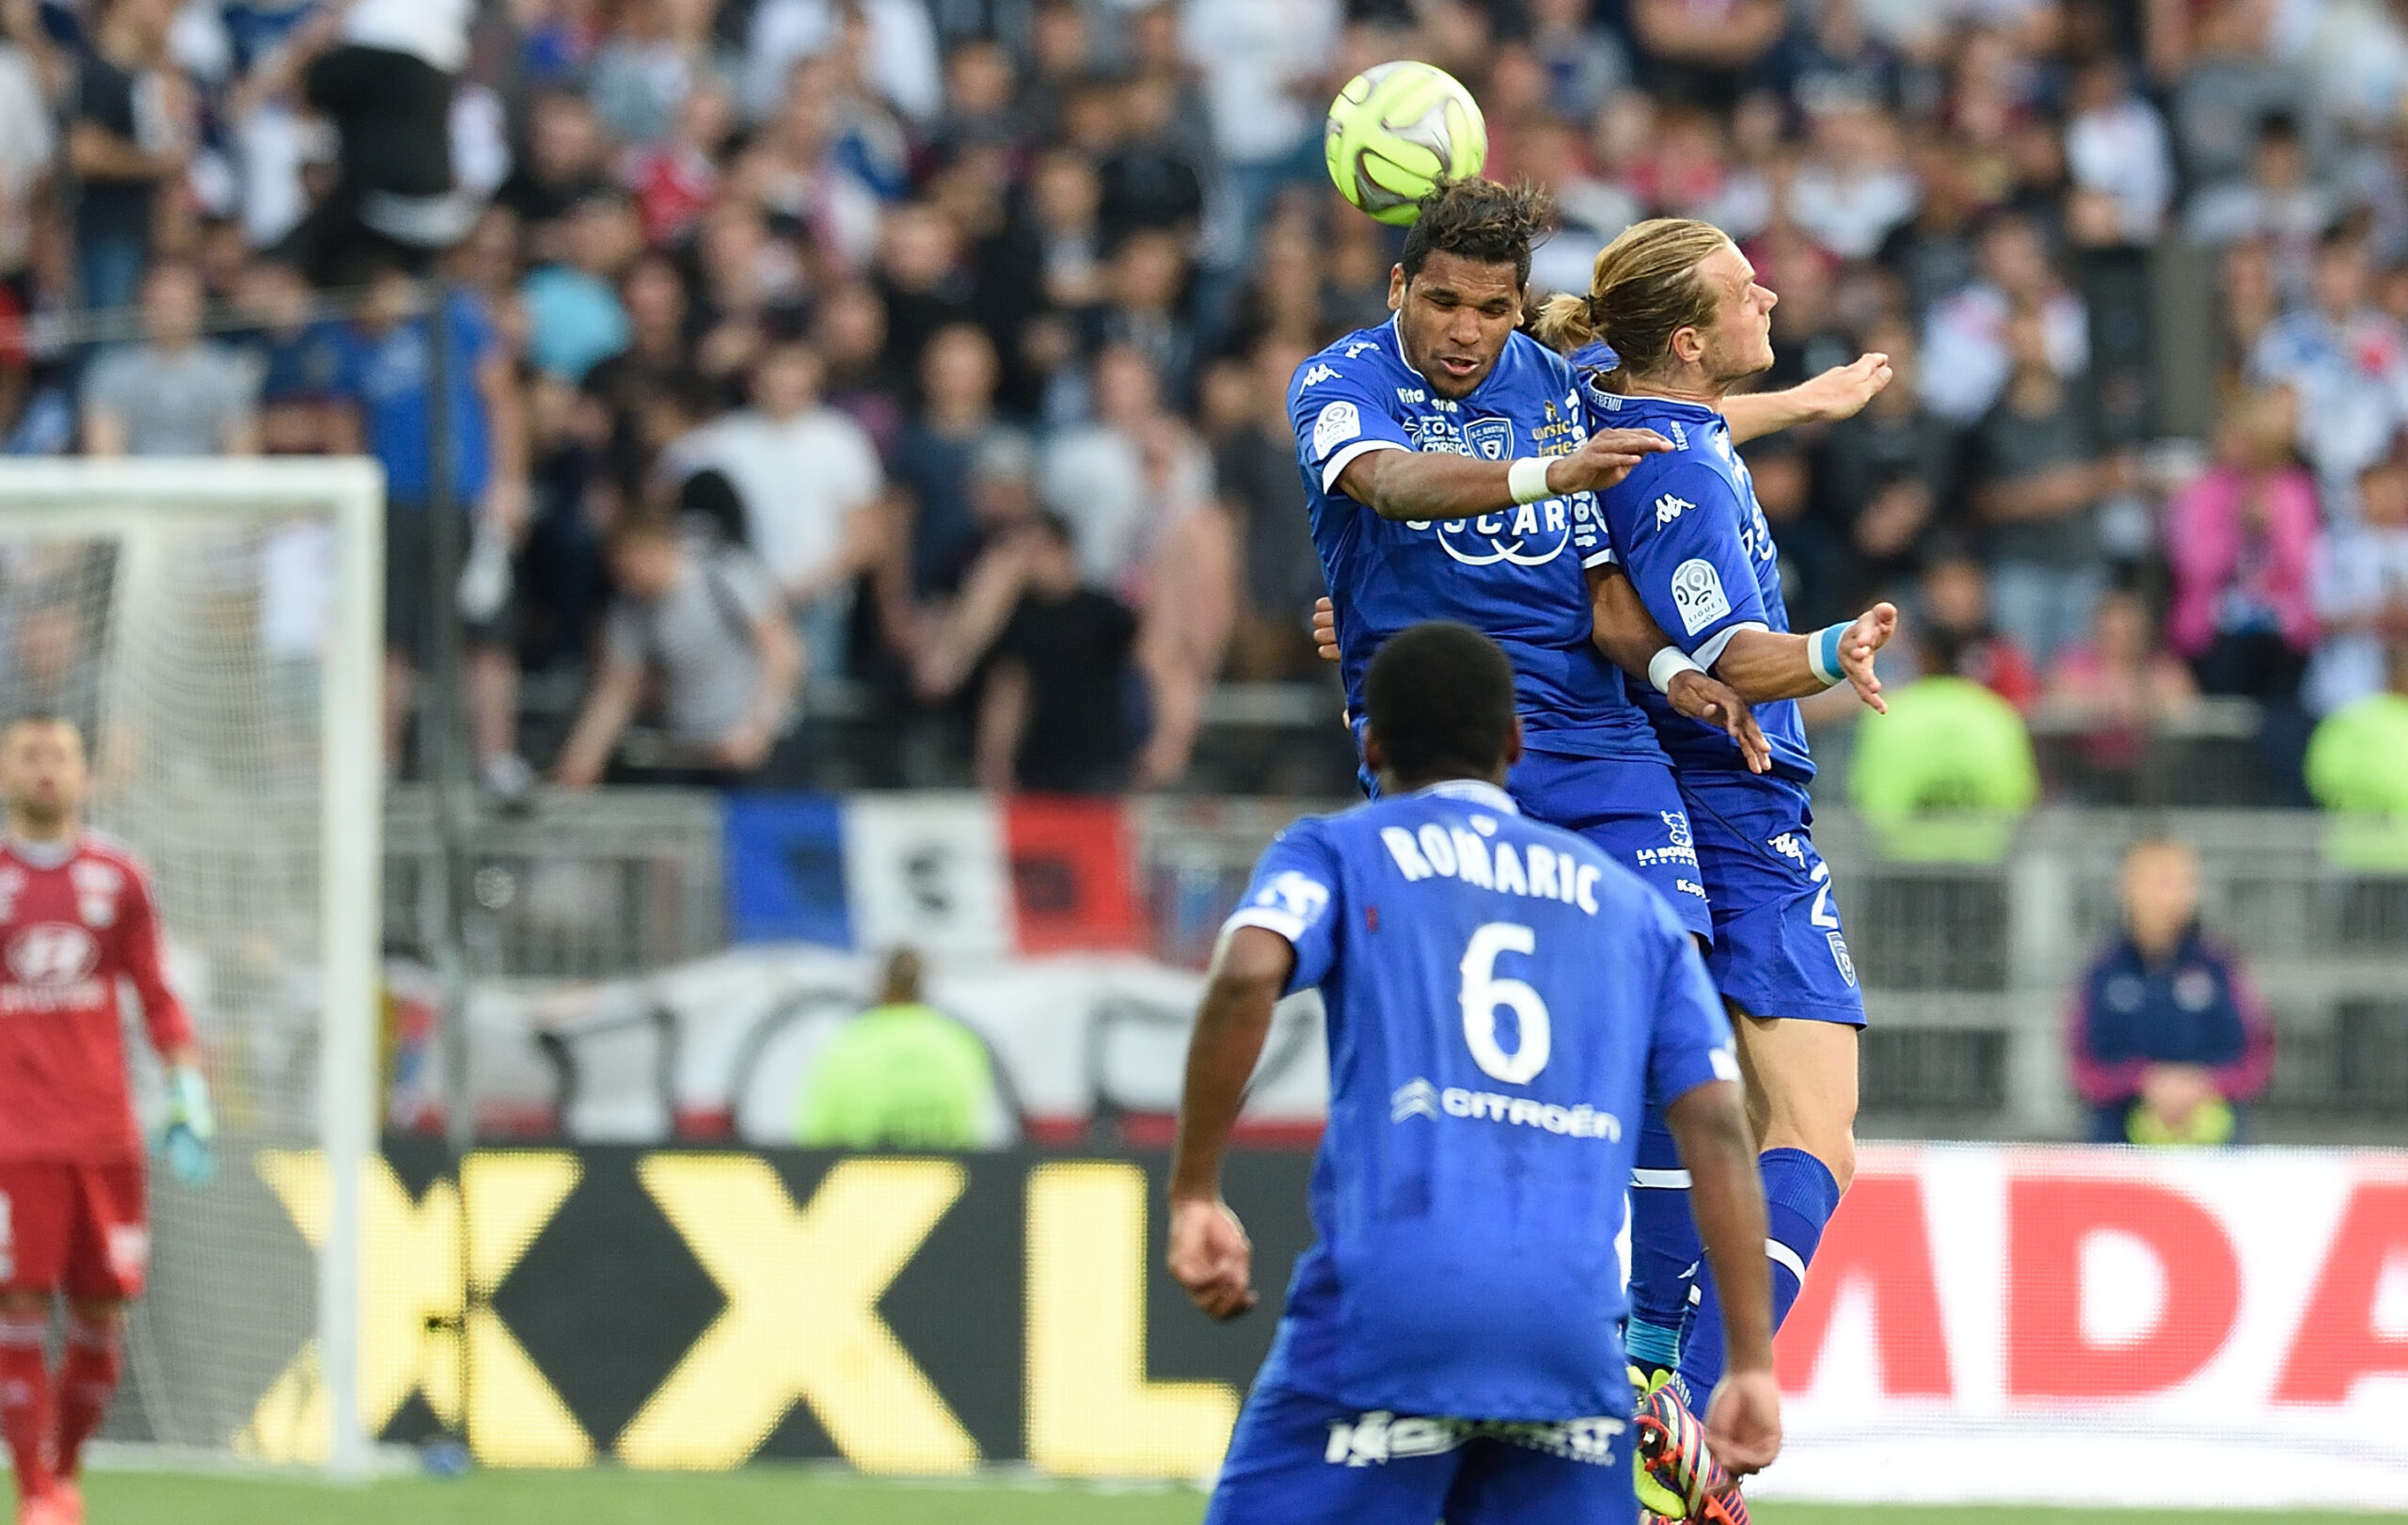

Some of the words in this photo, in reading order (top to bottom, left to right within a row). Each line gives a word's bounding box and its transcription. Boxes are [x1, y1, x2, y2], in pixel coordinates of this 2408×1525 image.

[1688, 603, 1716, 623] LIGUE
[1381, 822, 1601, 915] ROMARIC
[1637, 849, 1657, 861] LA
[1460, 922, 1551, 1086] 6
[235, 1150, 1240, 1477] XXL
